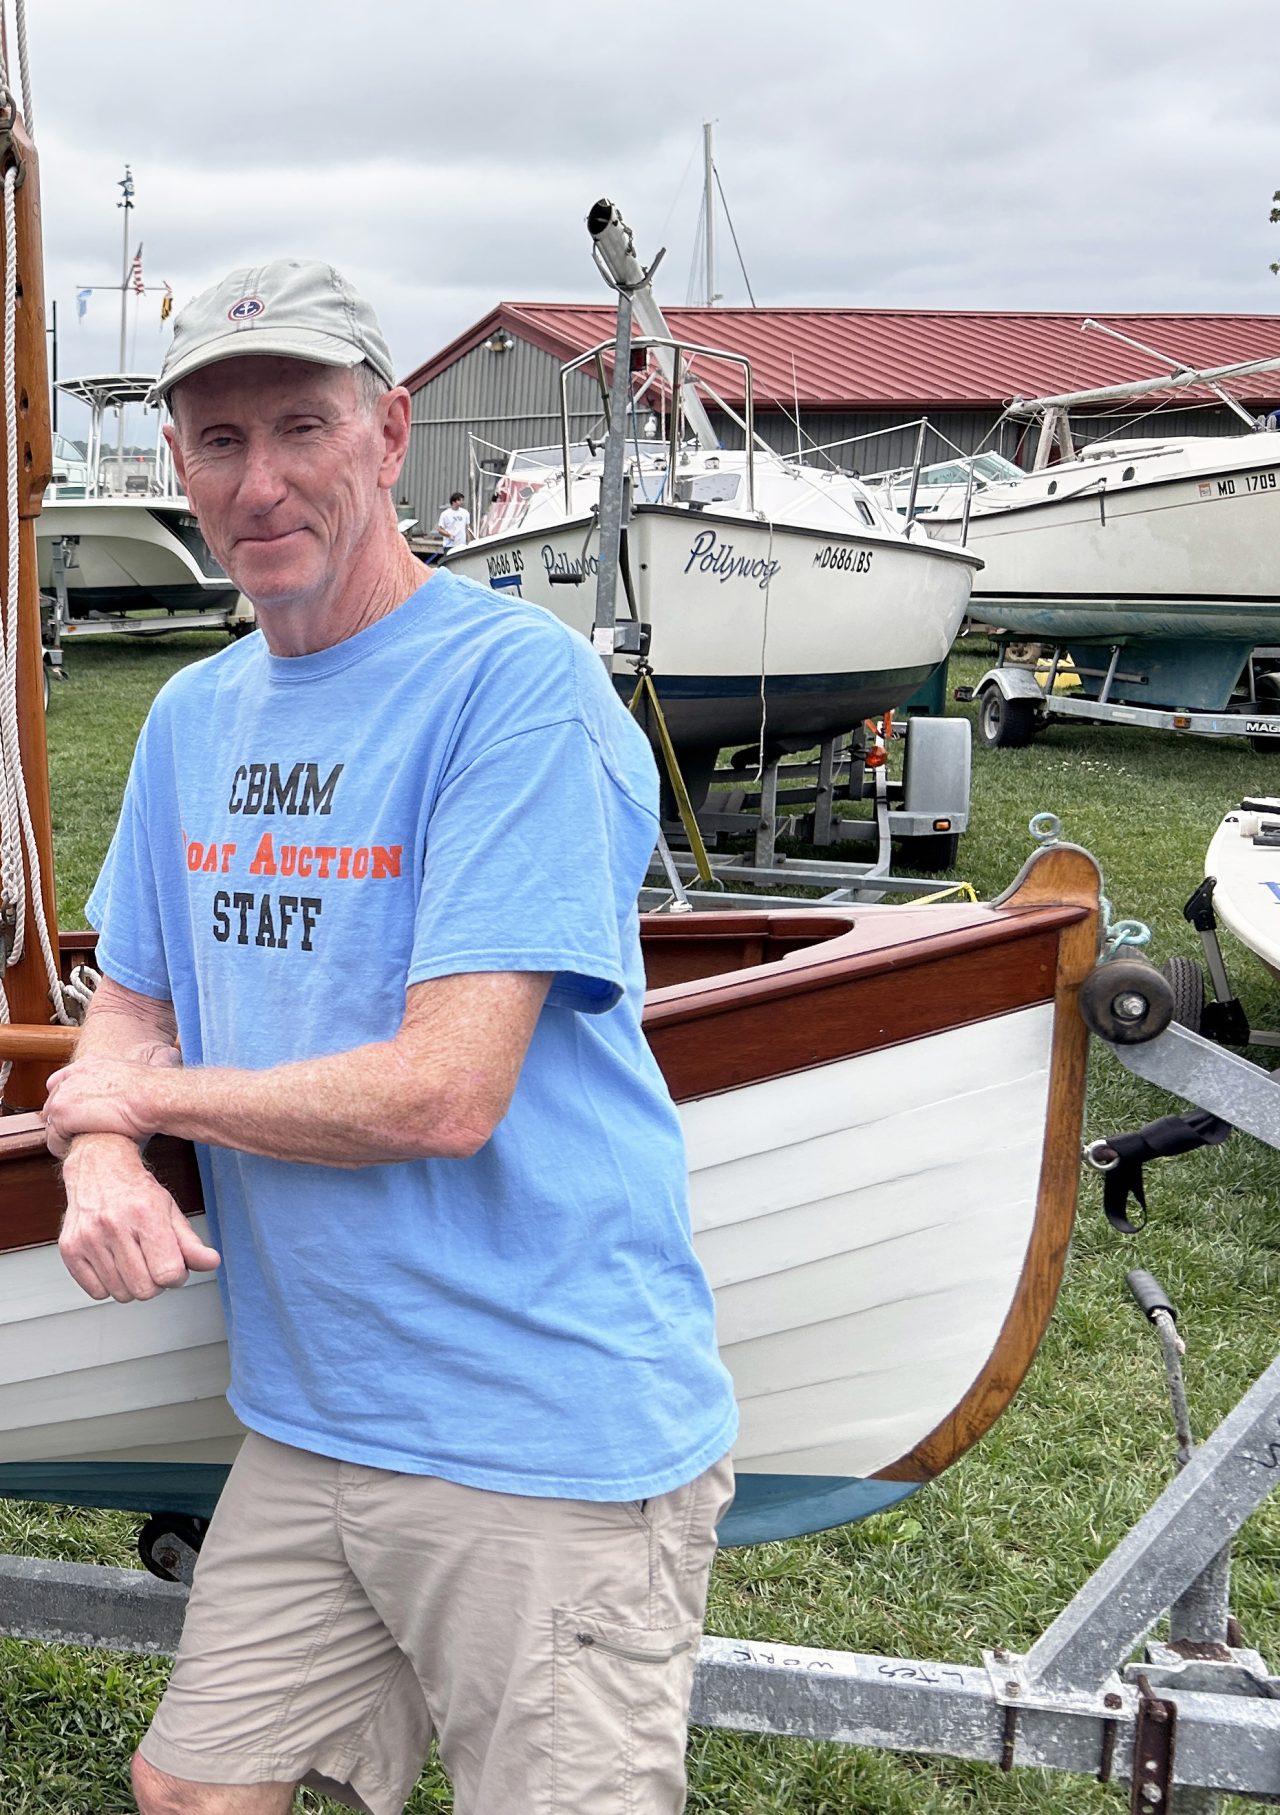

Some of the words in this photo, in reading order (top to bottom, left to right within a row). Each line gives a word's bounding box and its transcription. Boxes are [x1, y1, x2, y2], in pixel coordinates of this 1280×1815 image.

[1245, 473, 1277, 492] 1709
[684, 530, 782, 590] Pollywog
[1246, 722, 1280, 733] MAG
[228, 762, 345, 816] CBMM
[181, 830, 237, 873] OAT
[249, 832, 404, 880] AUCTION
[213, 890, 322, 952] STAFF
